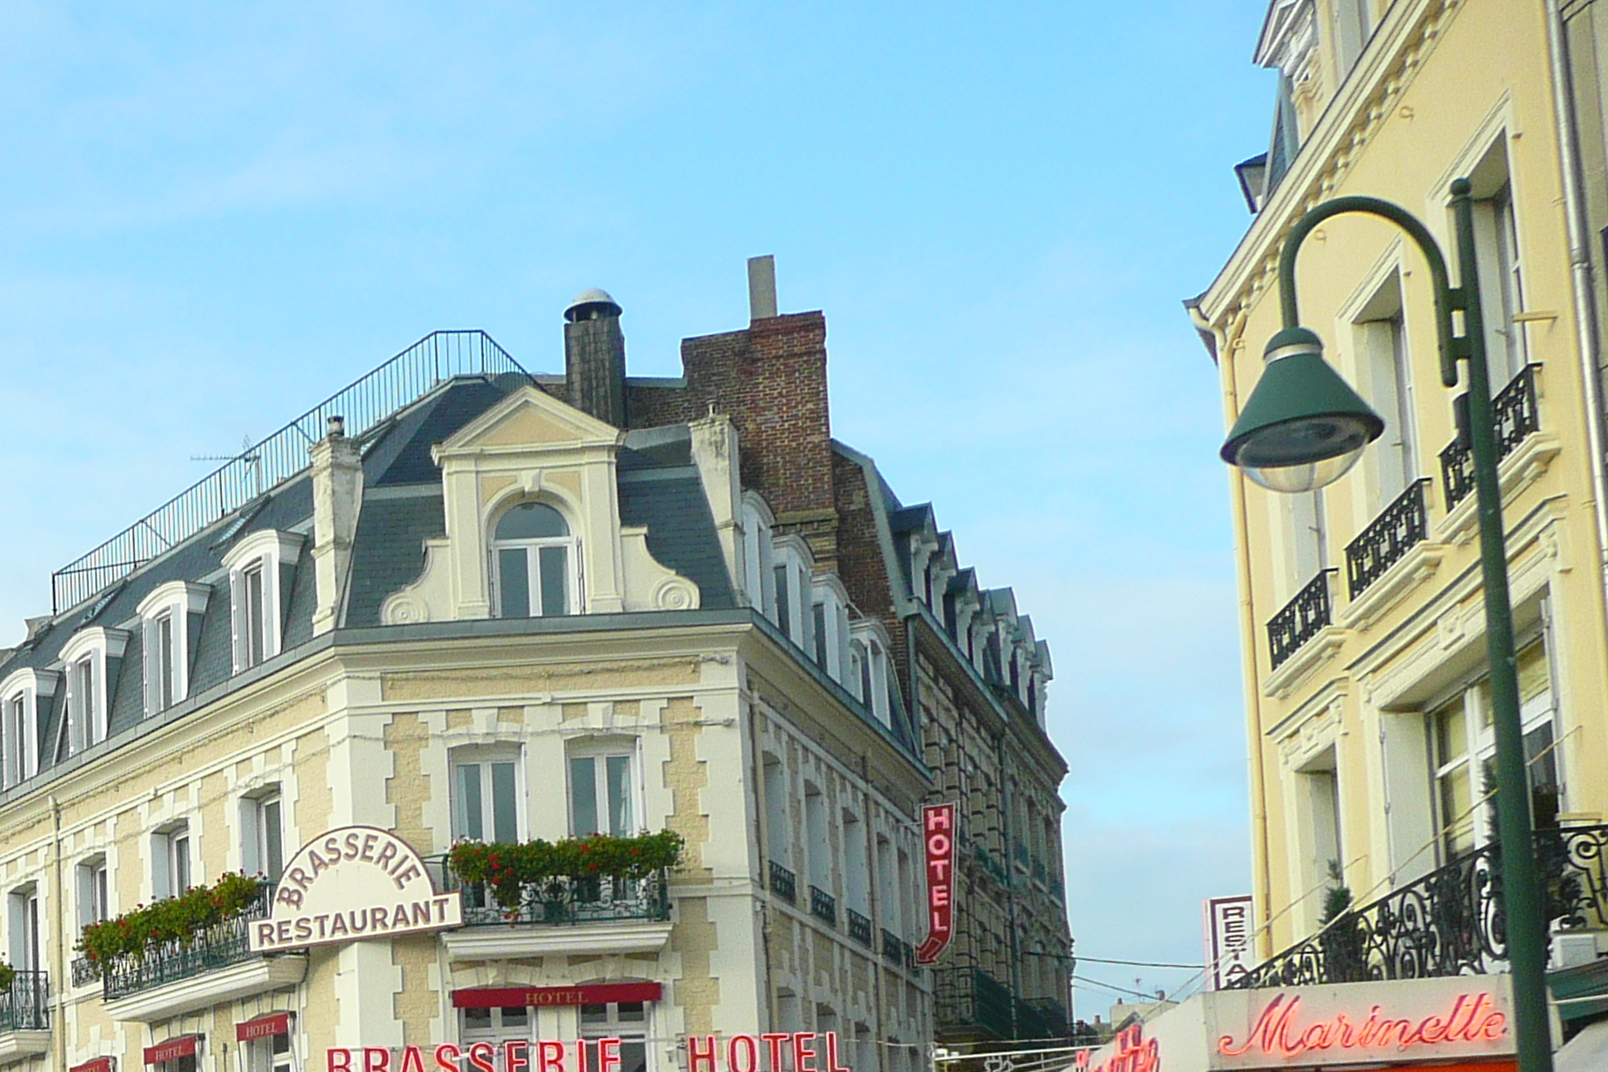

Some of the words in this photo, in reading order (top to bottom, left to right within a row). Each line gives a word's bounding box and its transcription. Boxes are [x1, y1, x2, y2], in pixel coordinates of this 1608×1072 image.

[276, 832, 421, 911] BRASSERIE
[927, 807, 950, 932] HOTEL
[257, 897, 450, 947] RESTAURANT
[525, 991, 589, 1005] HOTEL
[246, 1022, 277, 1037] HOTEL
[1217, 992, 1508, 1056] Marinette
[155, 1045, 183, 1062] HOTEL
